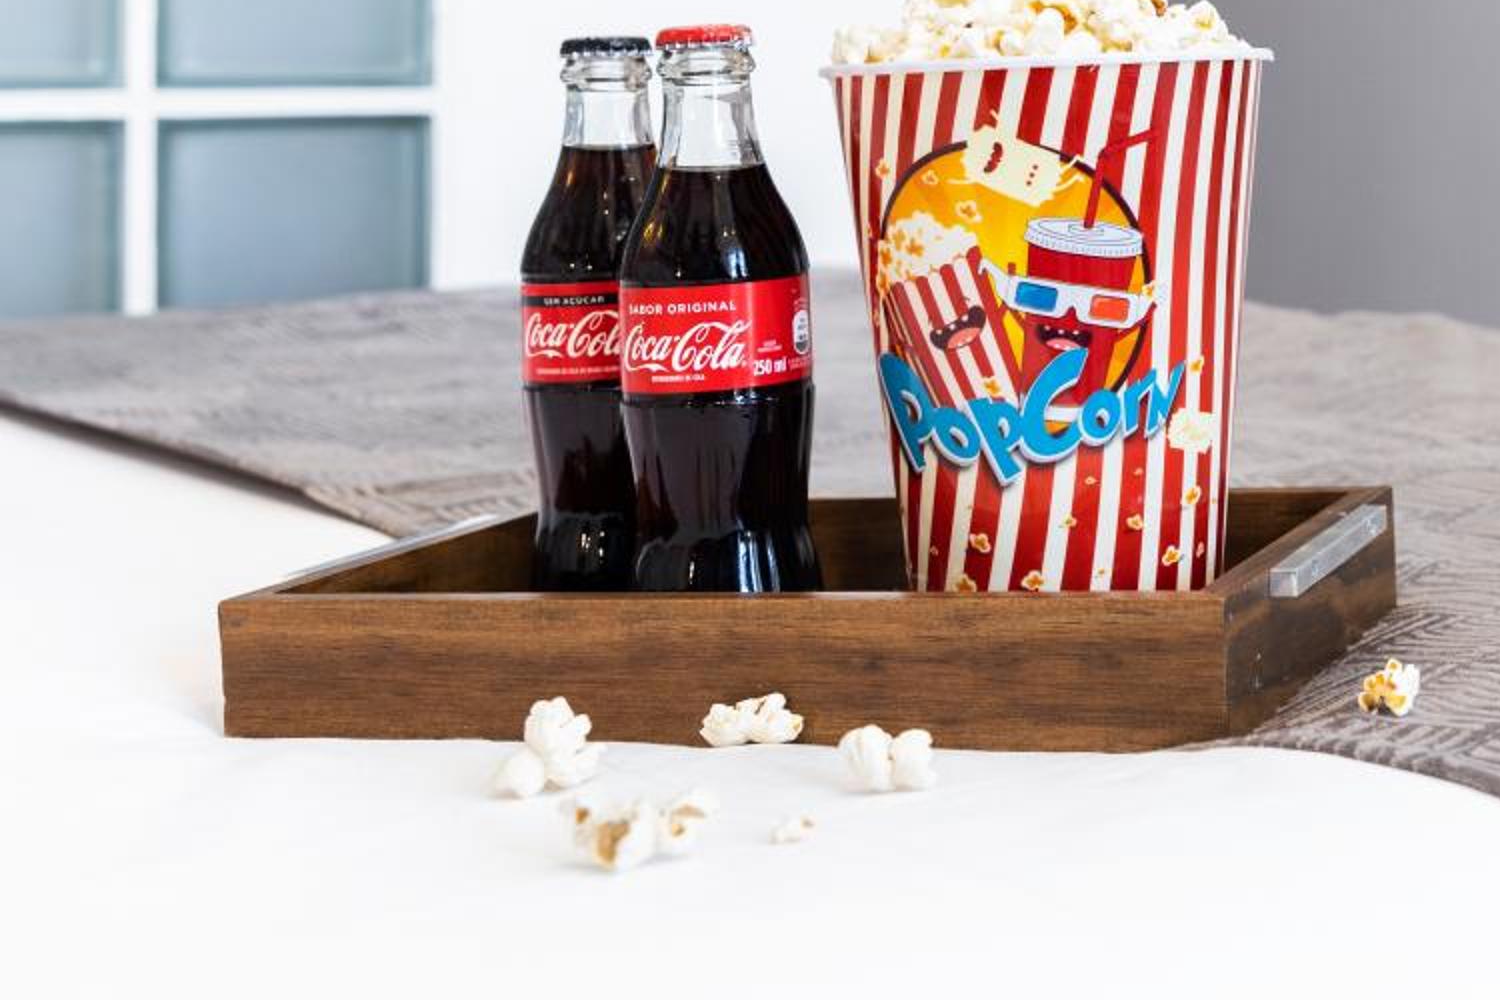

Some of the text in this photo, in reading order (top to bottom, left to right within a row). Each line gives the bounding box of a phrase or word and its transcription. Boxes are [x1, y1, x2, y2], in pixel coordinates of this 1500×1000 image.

[629, 300, 737, 315] SABOR ORIGINAL
[525, 311, 620, 358] Coca-Col
[624, 319, 752, 372] Coca-Cola
[753, 359, 773, 377] 250
[774, 356, 788, 373] ml
